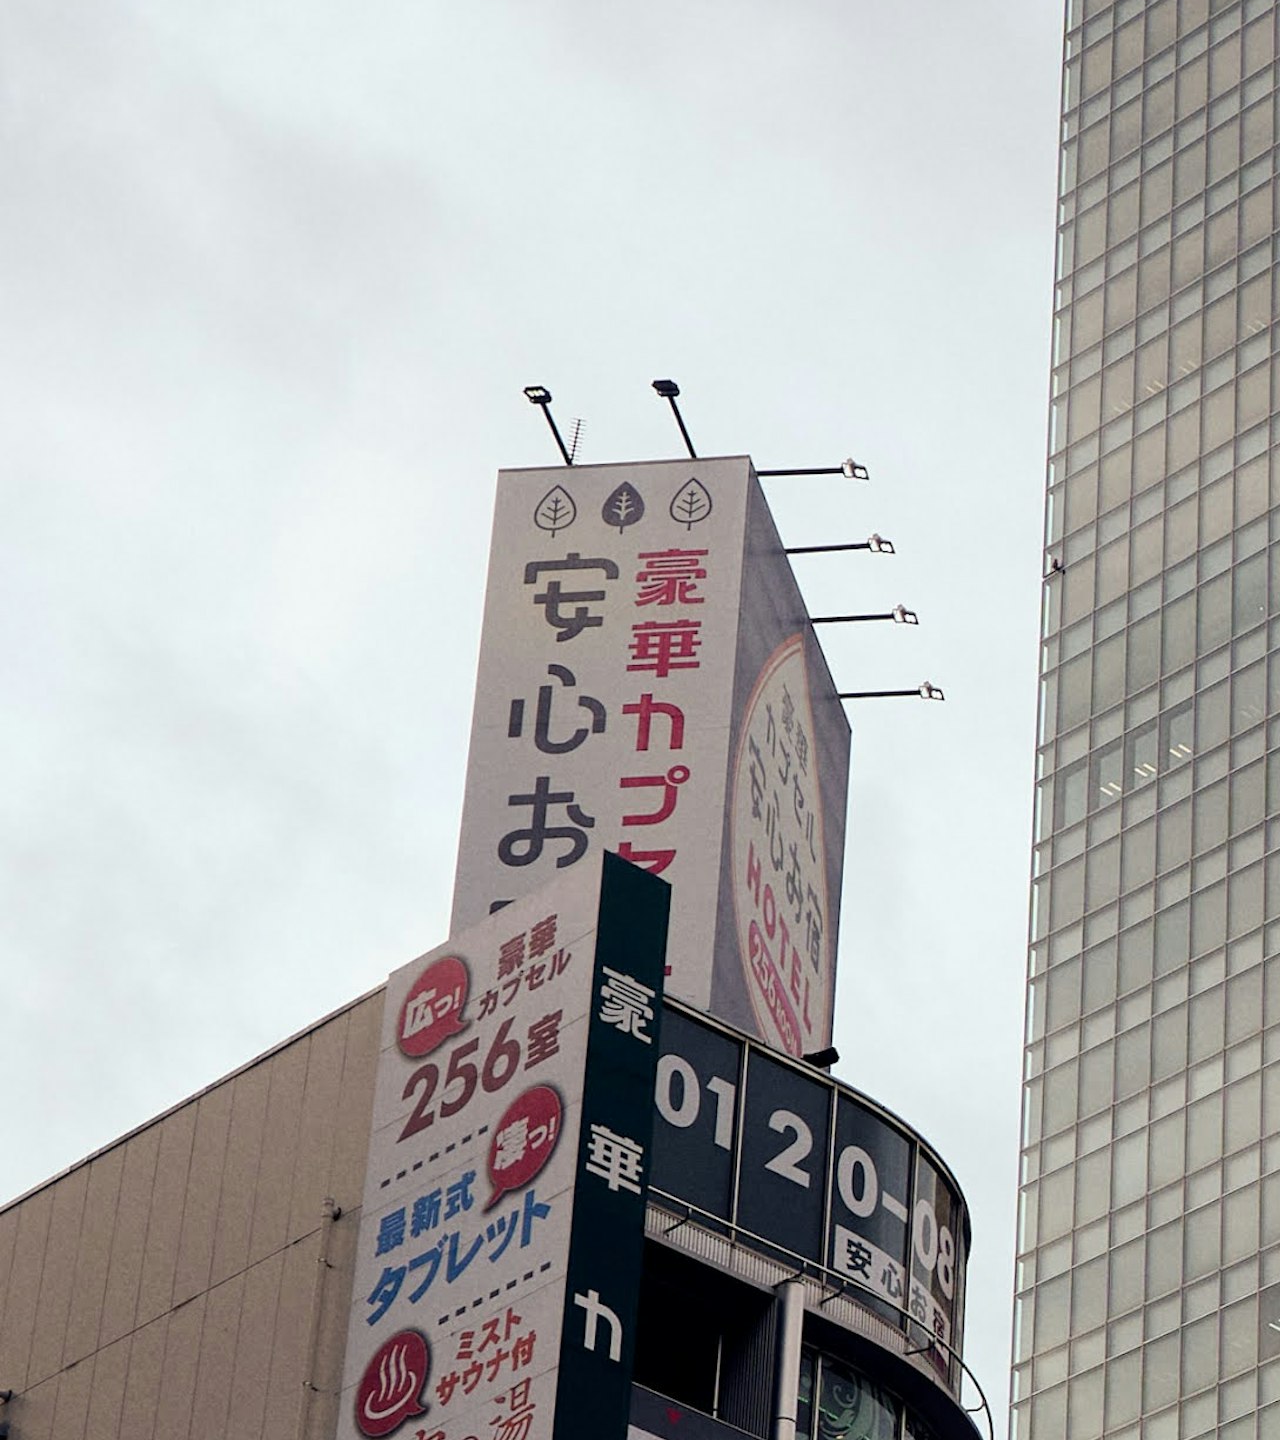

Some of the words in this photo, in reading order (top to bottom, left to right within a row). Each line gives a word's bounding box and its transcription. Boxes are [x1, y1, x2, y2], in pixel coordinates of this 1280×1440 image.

[496, 912, 559, 980] 豪華
[745, 837, 814, 1036] HOTEL
[475, 948, 572, 1021] カプセル
[395, 1009, 564, 1145] 256室
[374, 1169, 477, 1258] 最新式
[365, 1189, 552, 1327] タブレット
[435, 1329, 537, 1407] サウナ付
[455, 1307, 522, 1361] ミスト
